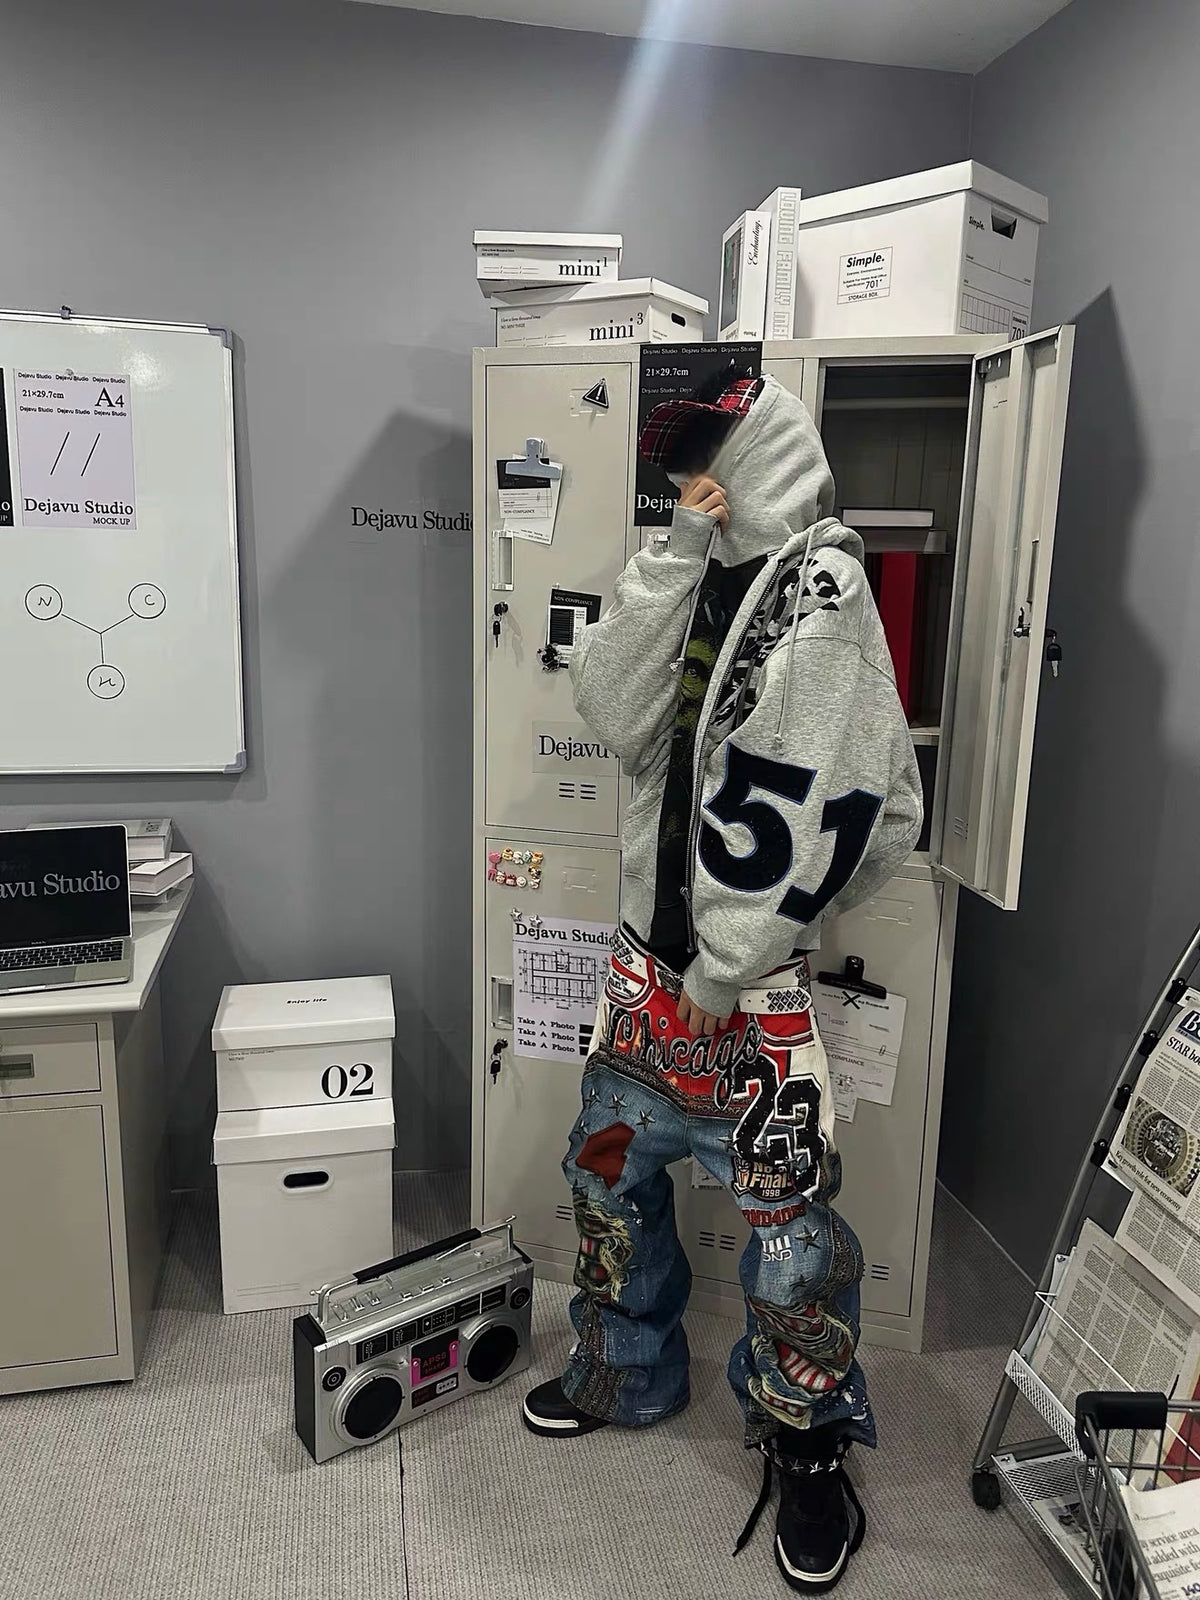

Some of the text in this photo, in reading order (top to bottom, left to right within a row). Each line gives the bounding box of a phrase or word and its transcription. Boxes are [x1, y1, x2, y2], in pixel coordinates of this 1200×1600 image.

[846, 252, 885, 268] Simple.
[94, 386, 125, 408] A4
[24, 498, 79, 516] Dejavu
[84, 500, 134, 515] Studio
[92, 517, 131, 526] MOCK UP
[350, 506, 474, 532] Dejavu Studi
[144, 594, 155, 606] C
[538, 734, 610, 762] Dejavu
[698, 742, 885, 926] 51
[43, 870, 120, 896] Studio
[515, 923, 567, 942] Dejavu
[517, 1016, 536, 1025] Take
[550, 1021, 575, 1030] Photo
[517, 1027, 536, 1036] Take
[551, 1032, 575, 1042] Photo
[517, 1038, 537, 1047] Take
[551, 1043, 576, 1053] Photo
[1166, 1036, 1191, 1058] STAR
[606, 1001, 764, 1111] Chicago
[321, 1062, 375, 1099] 02
[731, 1052, 827, 1203] 23
[761, 1189, 781, 1197] 1998
[1148, 1531, 1177, 1547] service
[1150, 1546, 1180, 1565] added
[1178, 1541, 1200, 1557] with
